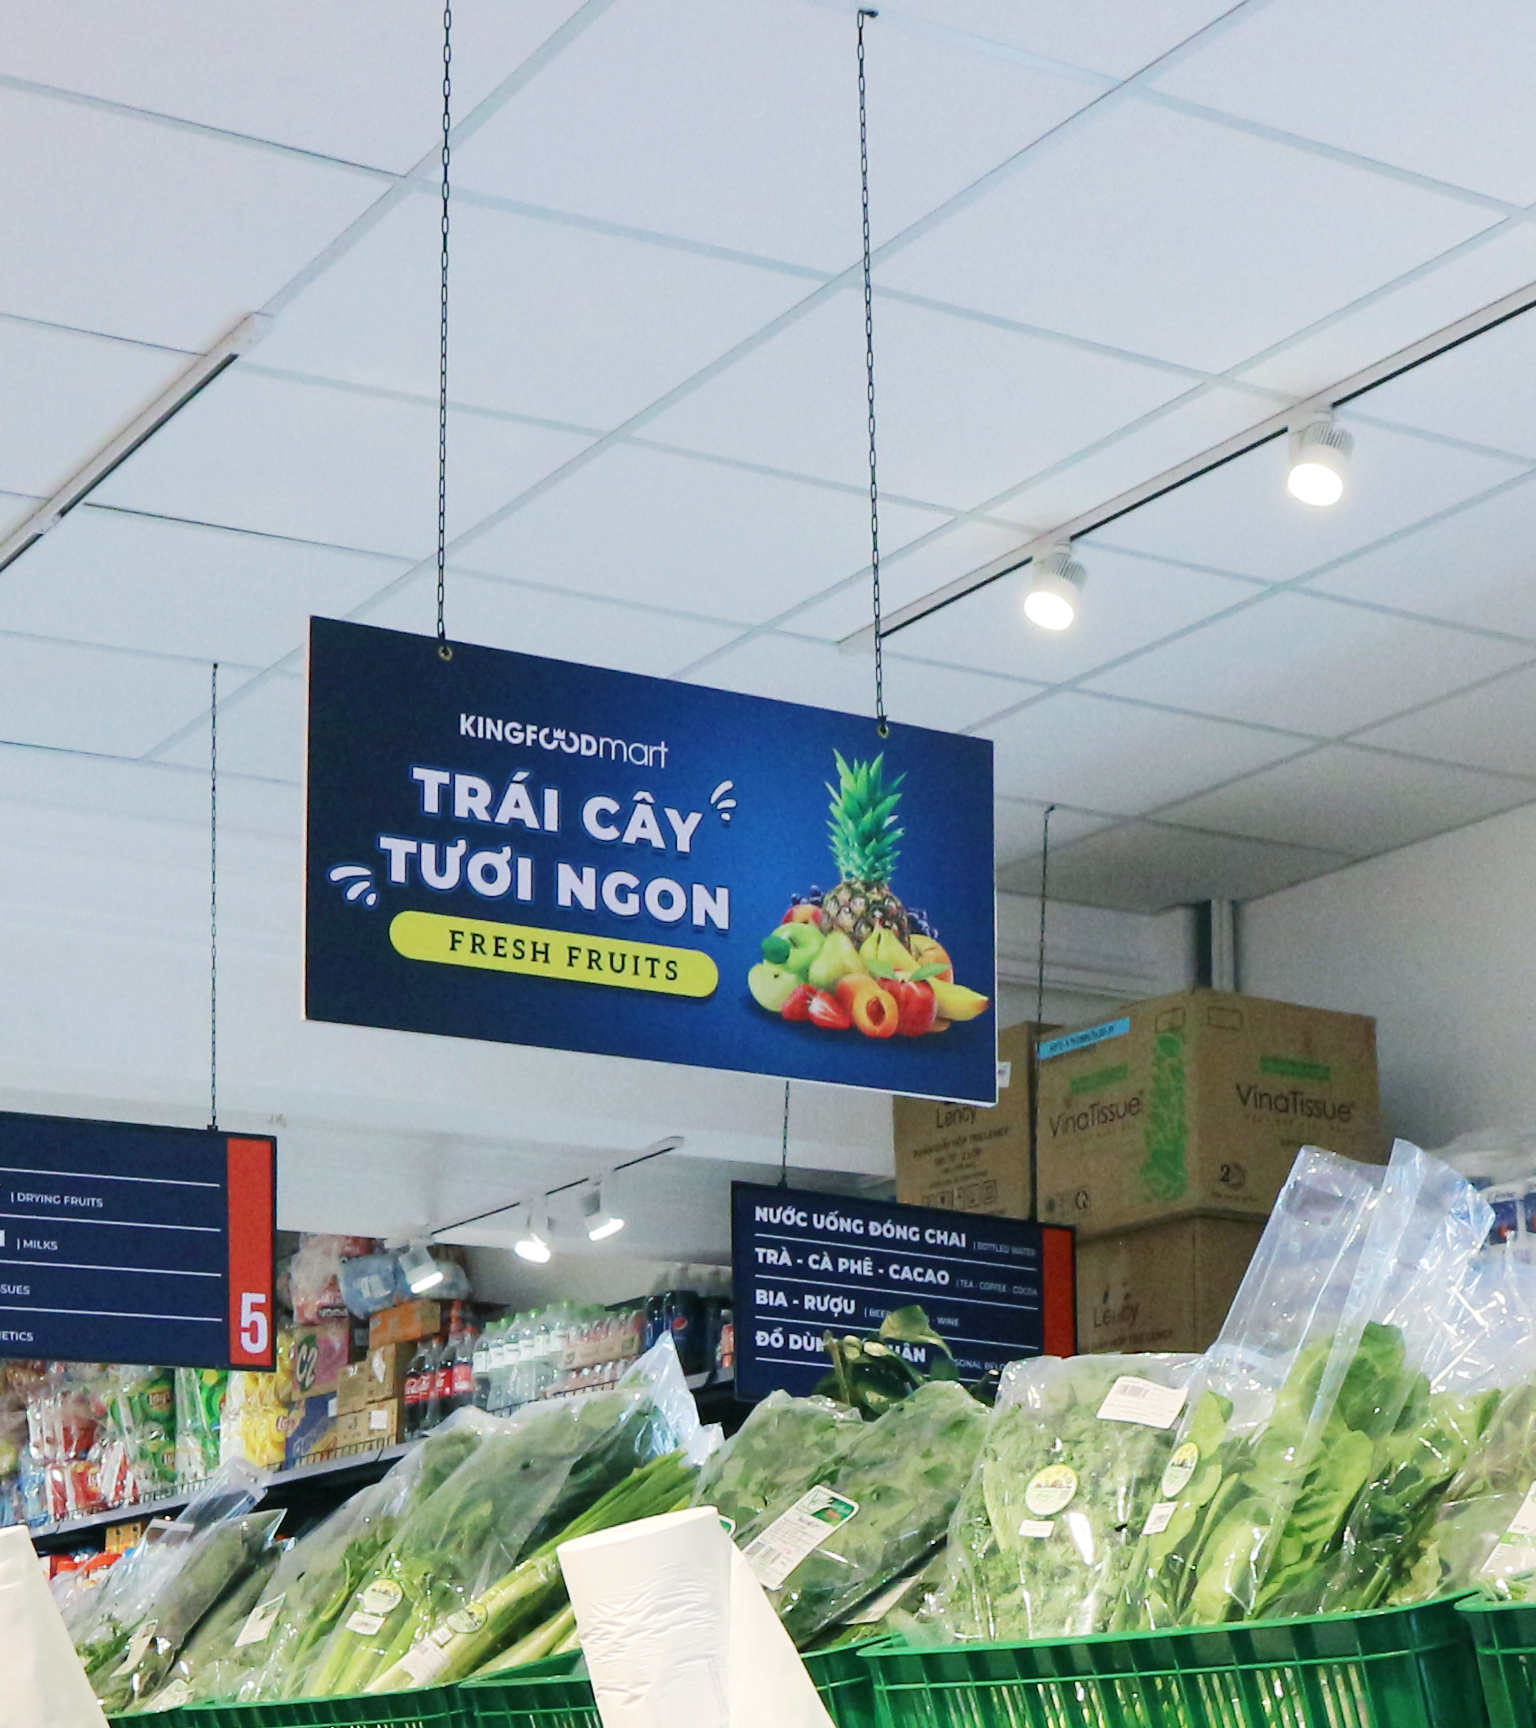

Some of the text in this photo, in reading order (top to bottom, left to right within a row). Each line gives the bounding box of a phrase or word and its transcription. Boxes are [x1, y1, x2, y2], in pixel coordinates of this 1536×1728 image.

[411, 765, 702, 855] TRÁI CÂY
[379, 835, 730, 931] TƯƠI NGON
[448, 928, 679, 981] FRESH FRUITS
[1049, 1095, 1142, 1138] VinaTissue
[1235, 1082, 1354, 1123] VinaTissue
[16, 1191, 61, 1206] DRYING
[64, 1195, 104, 1208] FRUITS
[22, 1238, 58, 1251] MILKS
[755, 1205, 808, 1229] NƯỚC
[812, 1209, 864, 1236] UỐNG
[868, 1217, 920, 1244] ĐÓNG
[925, 1228, 966, 1249] CHAI
[755, 1245, 792, 1267] TRÀ
[808, 1249, 834, 1272] CÀ
[838, 1254, 874, 1278] PHÊ
[889, 1265, 950, 1286] CACAO
[240, 1292, 268, 1355] 5
[755, 1289, 788, 1308] BIA
[804, 1291, 856, 1318] RƯỢU
[754, 1328, 784, 1348] ĐỒ
